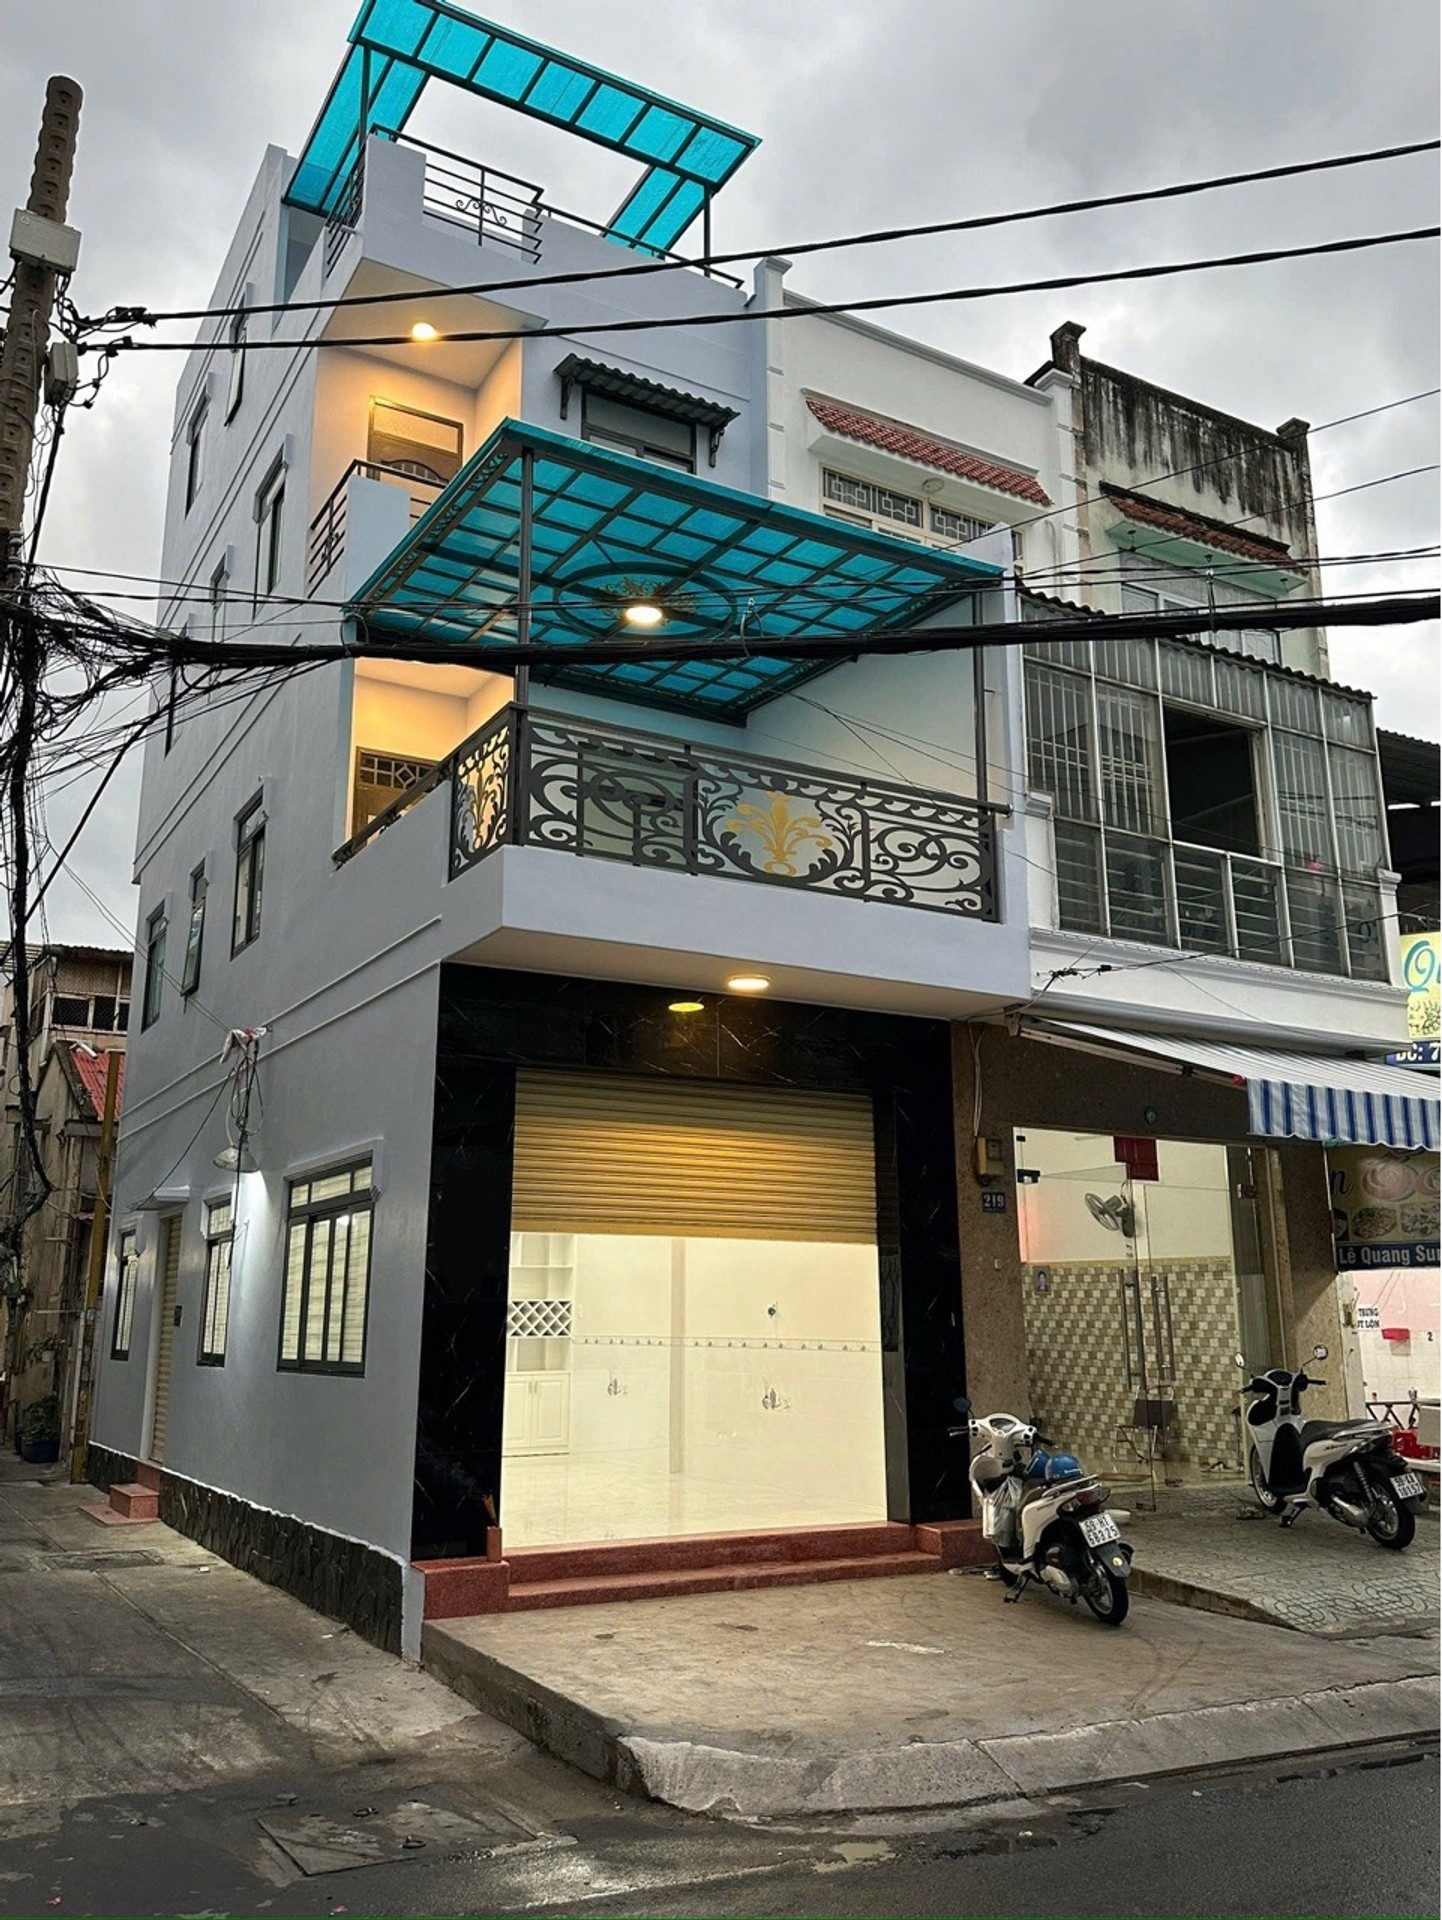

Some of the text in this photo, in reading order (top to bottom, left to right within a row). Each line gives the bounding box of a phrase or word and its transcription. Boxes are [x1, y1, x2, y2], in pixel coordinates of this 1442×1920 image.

[1404, 940, 1440, 993] Q
[983, 1193, 1005, 1208] 219
[1339, 1247, 1356, 1264] Lê
[1361, 1246, 1410, 1266] Quang
